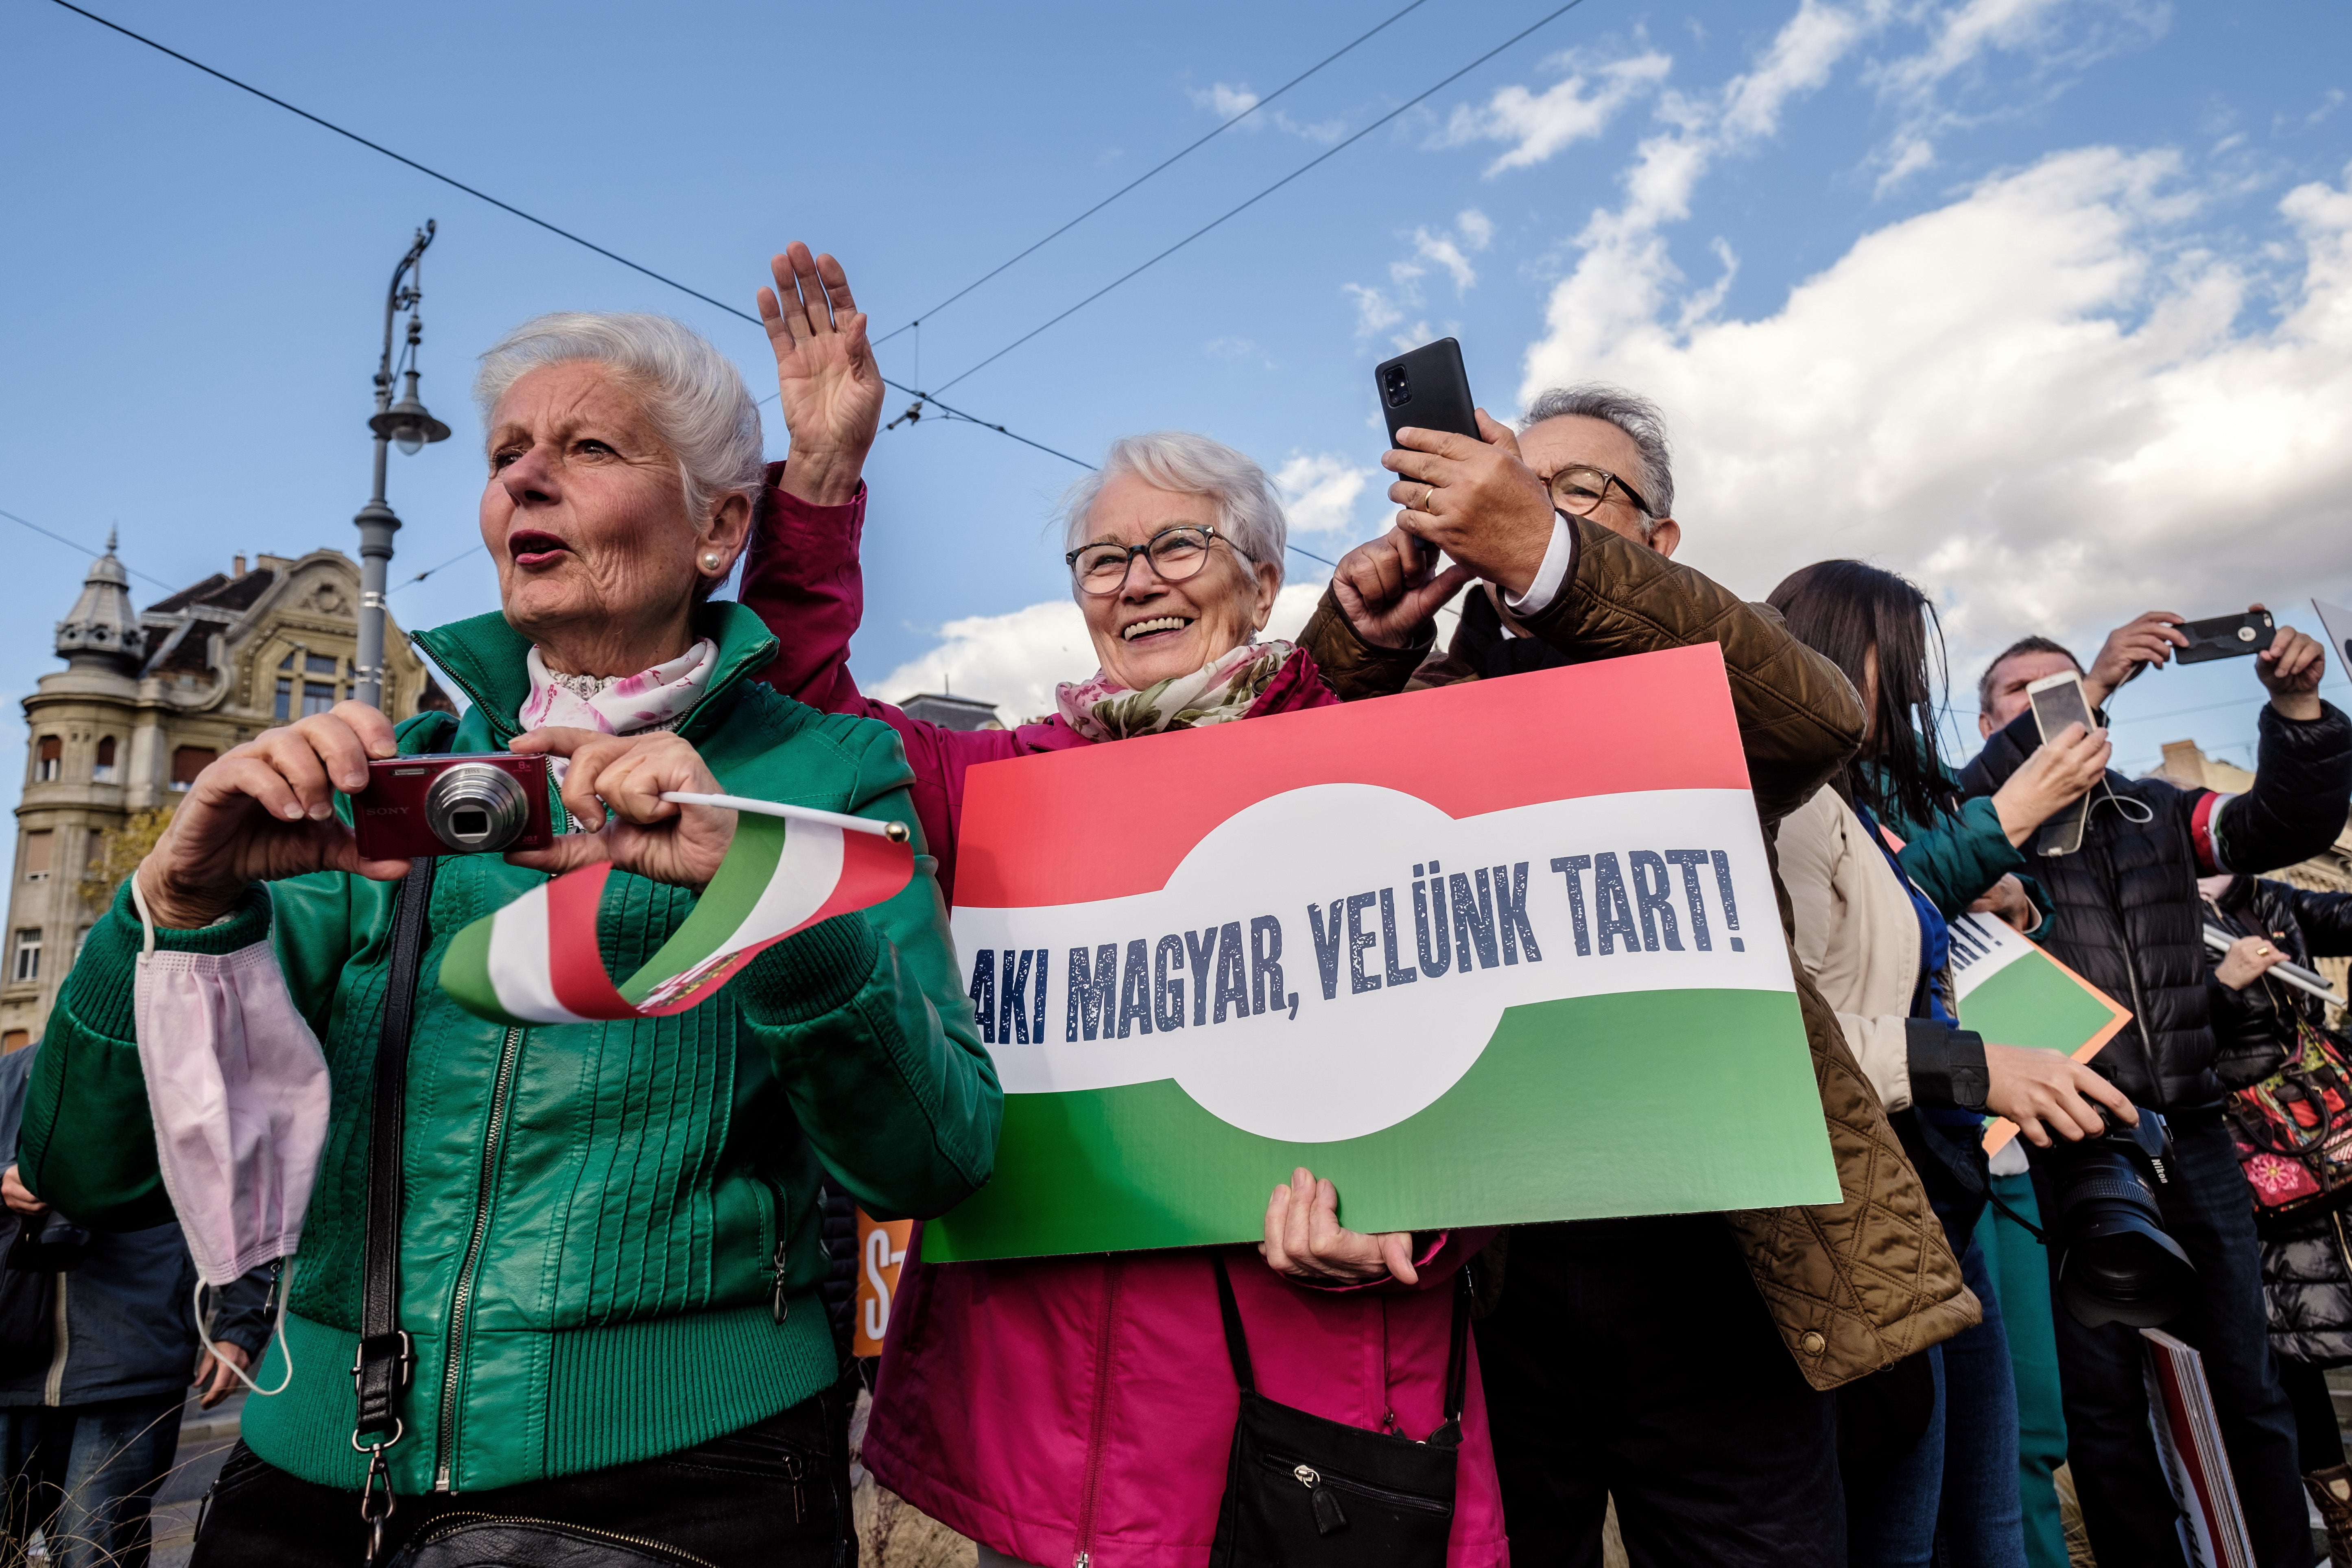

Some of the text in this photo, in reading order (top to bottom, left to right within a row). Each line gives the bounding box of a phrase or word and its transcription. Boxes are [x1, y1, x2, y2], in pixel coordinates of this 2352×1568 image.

[366, 807, 410, 815] SONY
[969, 849, 1745, 1044] AKI MAGYAR, VELÜNK TART!
[2151, 1159, 2168, 1184] Nikon
